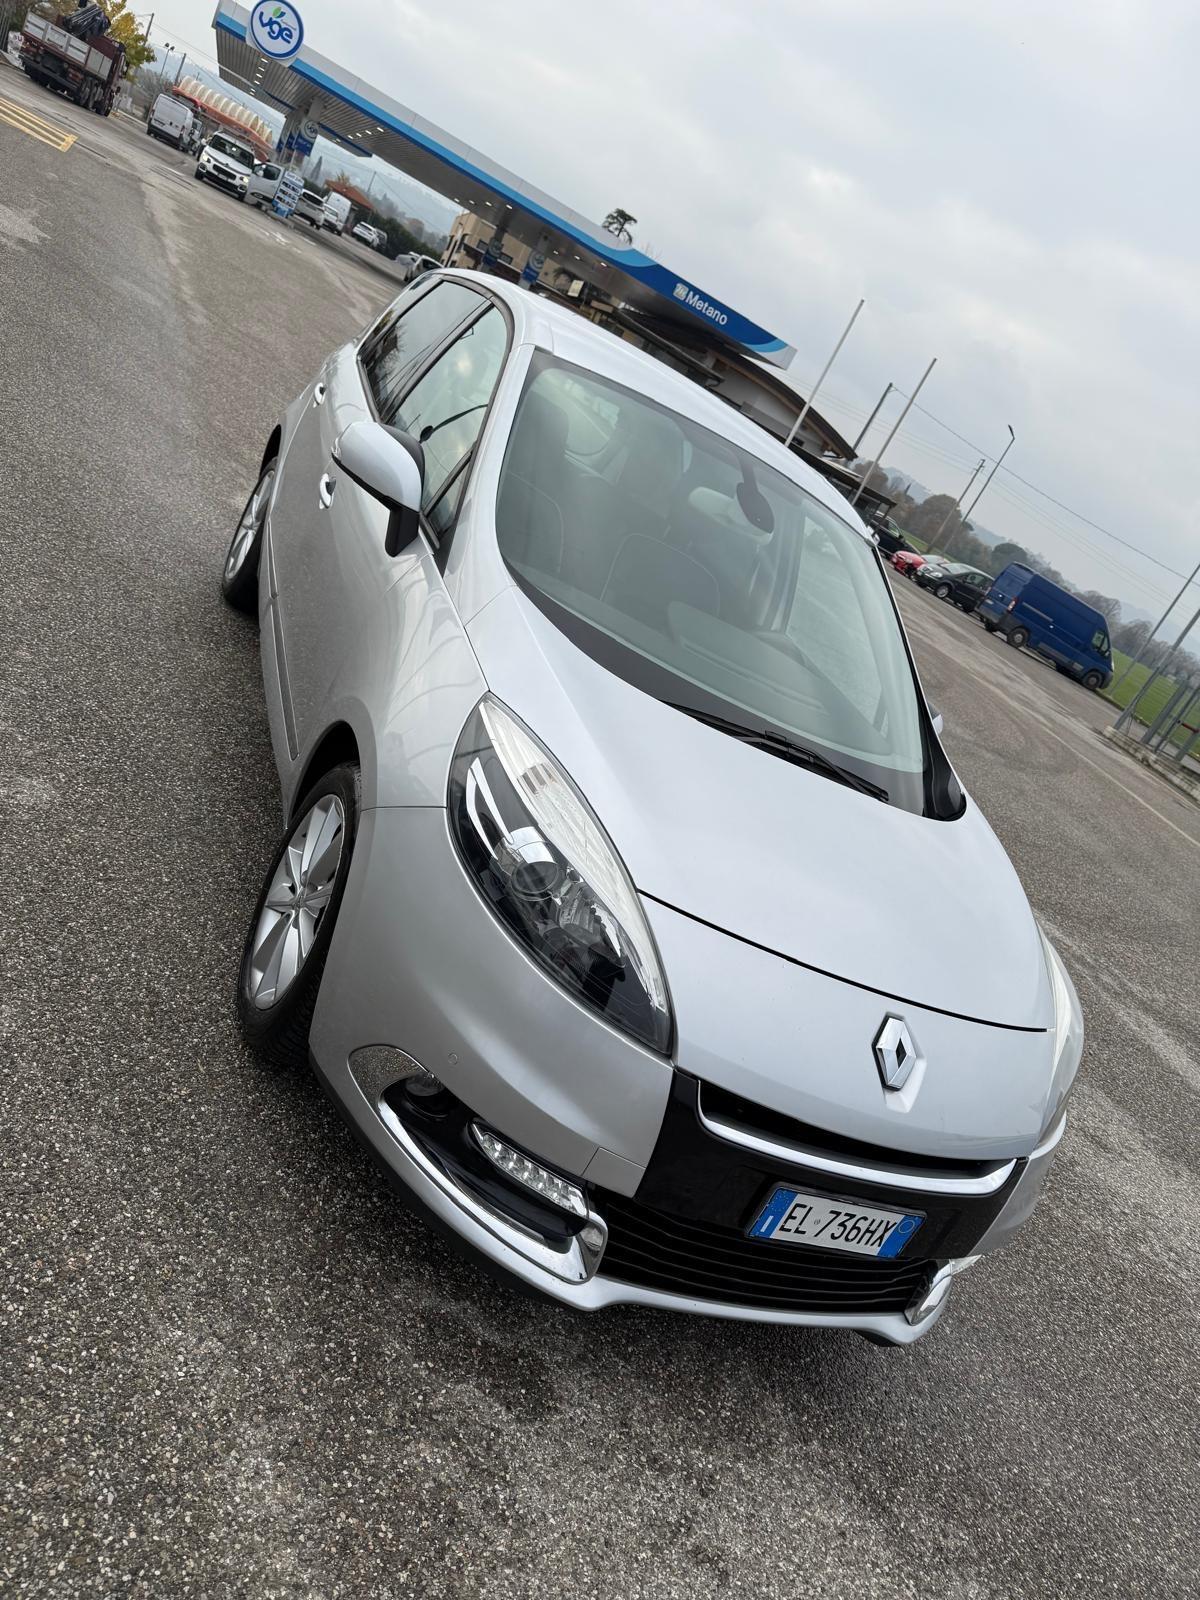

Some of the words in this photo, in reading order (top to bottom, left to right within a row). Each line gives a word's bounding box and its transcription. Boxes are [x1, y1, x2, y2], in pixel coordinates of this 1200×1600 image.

[685, 291, 728, 325] Metano
[760, 1215, 774, 1233] I
[778, 1203, 813, 1235] EL
[814, 1210, 897, 1248] 736HX
